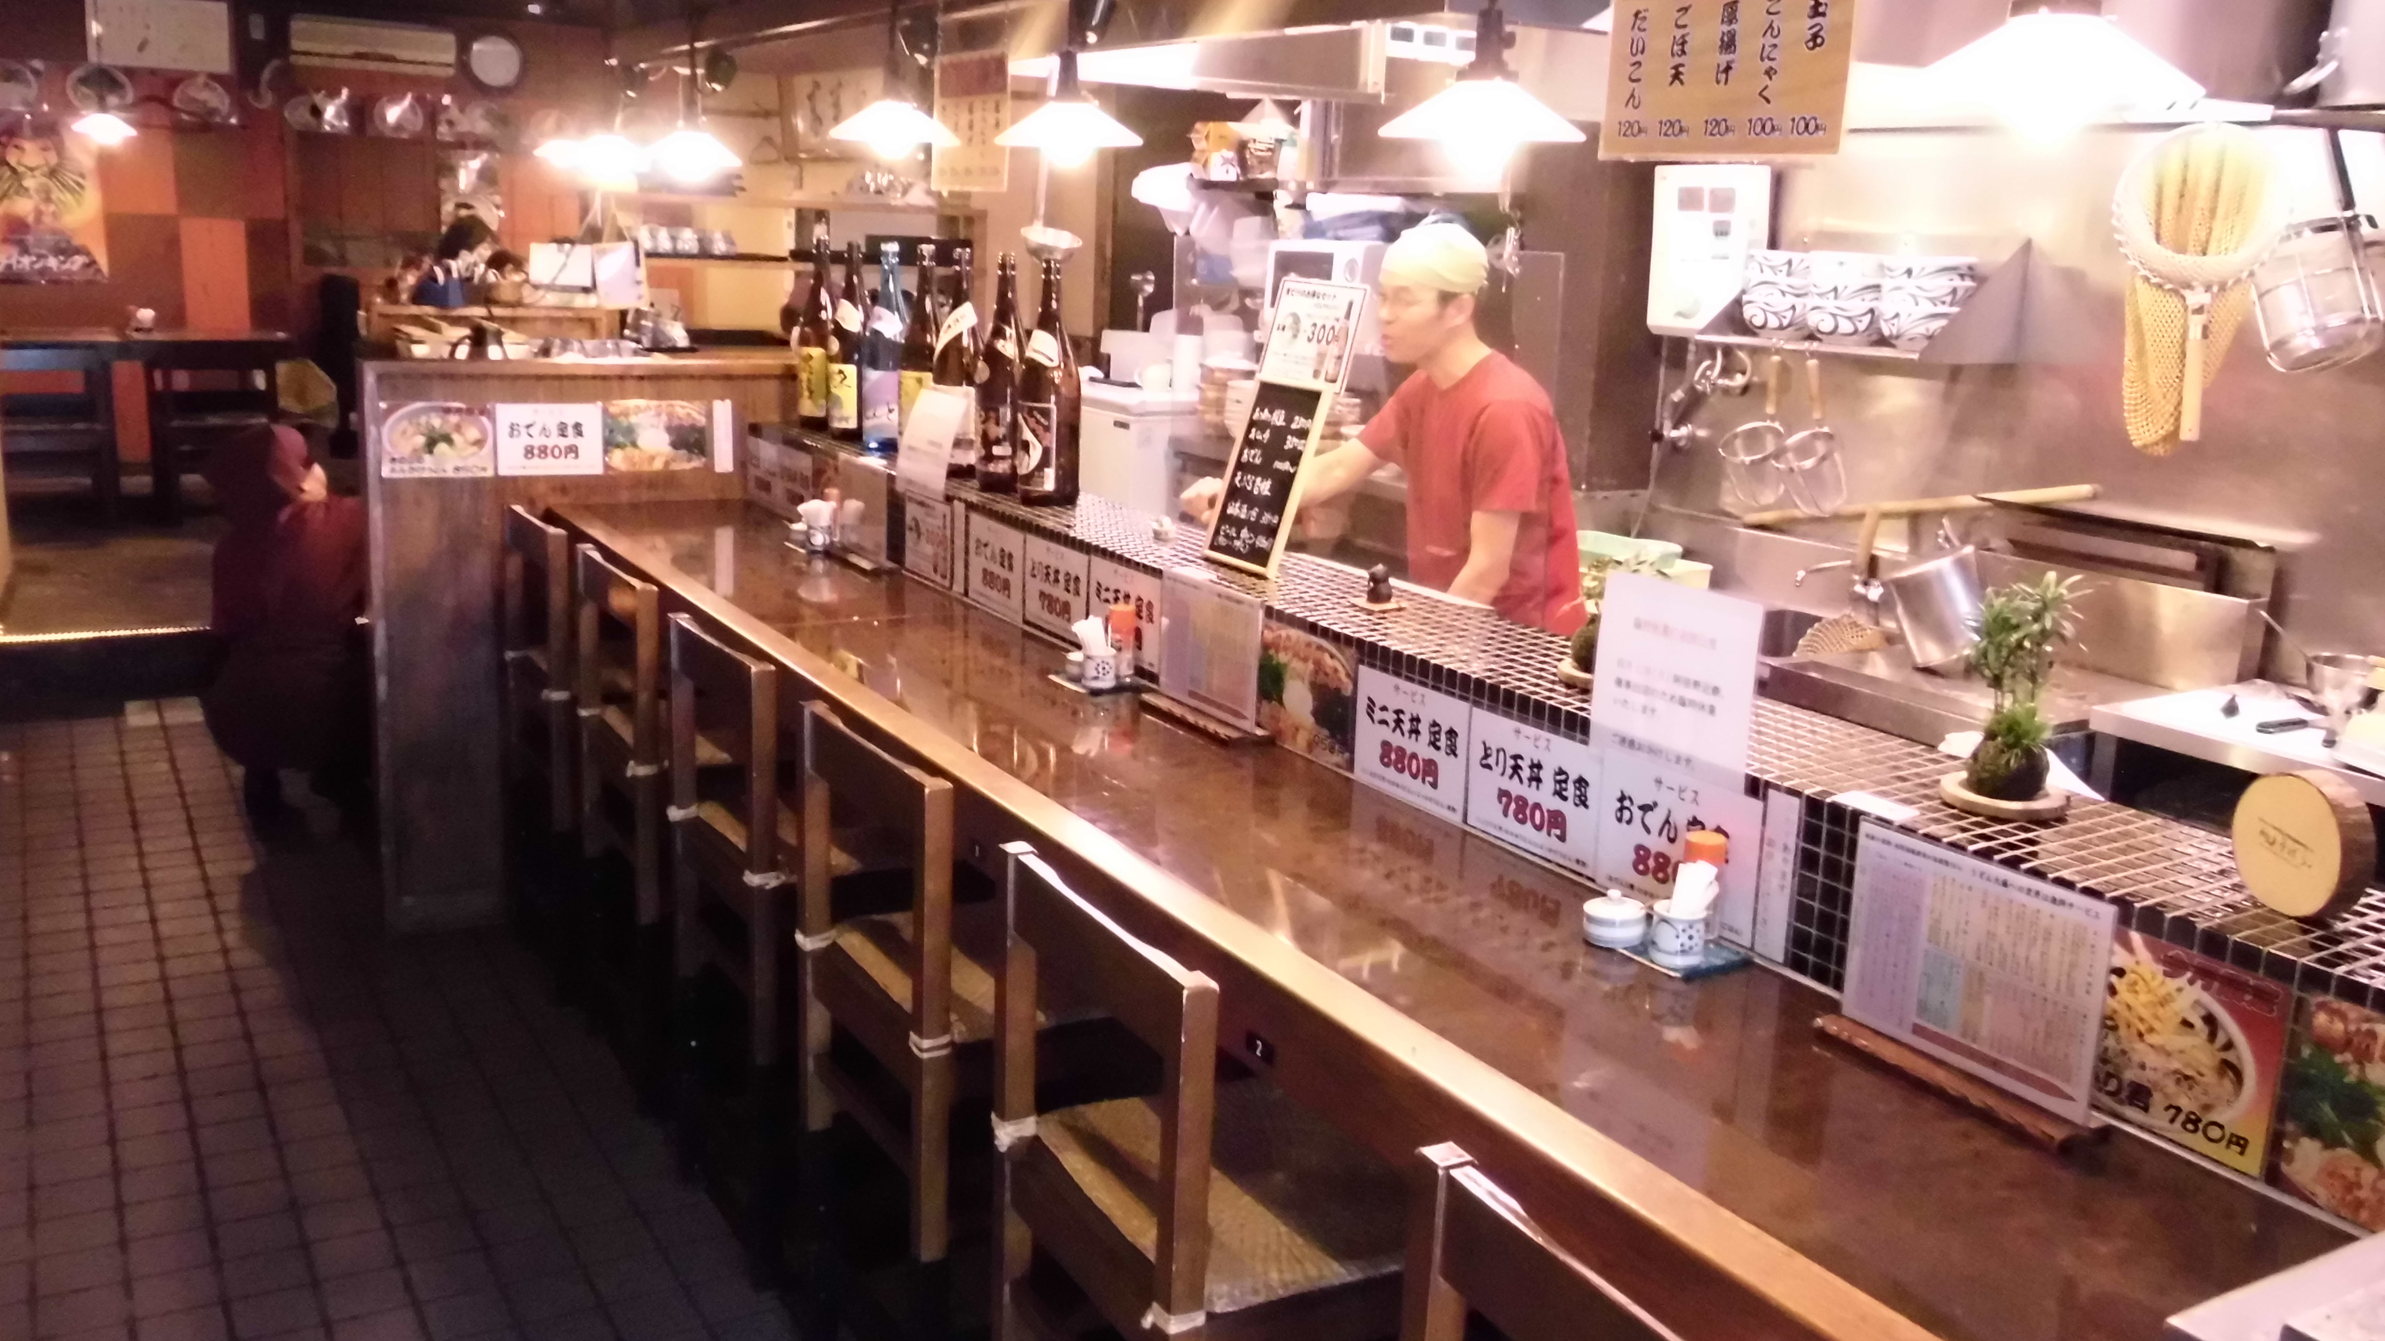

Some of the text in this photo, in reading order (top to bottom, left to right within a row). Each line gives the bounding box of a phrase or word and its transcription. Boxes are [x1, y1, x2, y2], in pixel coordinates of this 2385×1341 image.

[1625, 8, 1649, 109] だいこん
[1669, 4, 1691, 87] ごぼ天
[1716, 0, 1738, 86] 厚揚げ
[1759, 0, 1781, 105] こんにゃく
[508, 421, 551, 439] おでん
[522, 444, 580, 461] 880円
[1038, 590, 1072, 623] 780円
[1393, 683, 1426, 706] サービス
[1366, 696, 1459, 758] ミニ天丼 定食
[1513, 726, 1551, 752] サービス
[1379, 739, 1439, 790] 880円
[1479, 740, 1590, 810] とり天丼 定食
[1654, 777, 1700, 806] サービス
[1497, 787, 1567, 843] 780円
[1615, 789, 1678, 843] おでん
[2164, 1103, 2250, 1157] 780円
